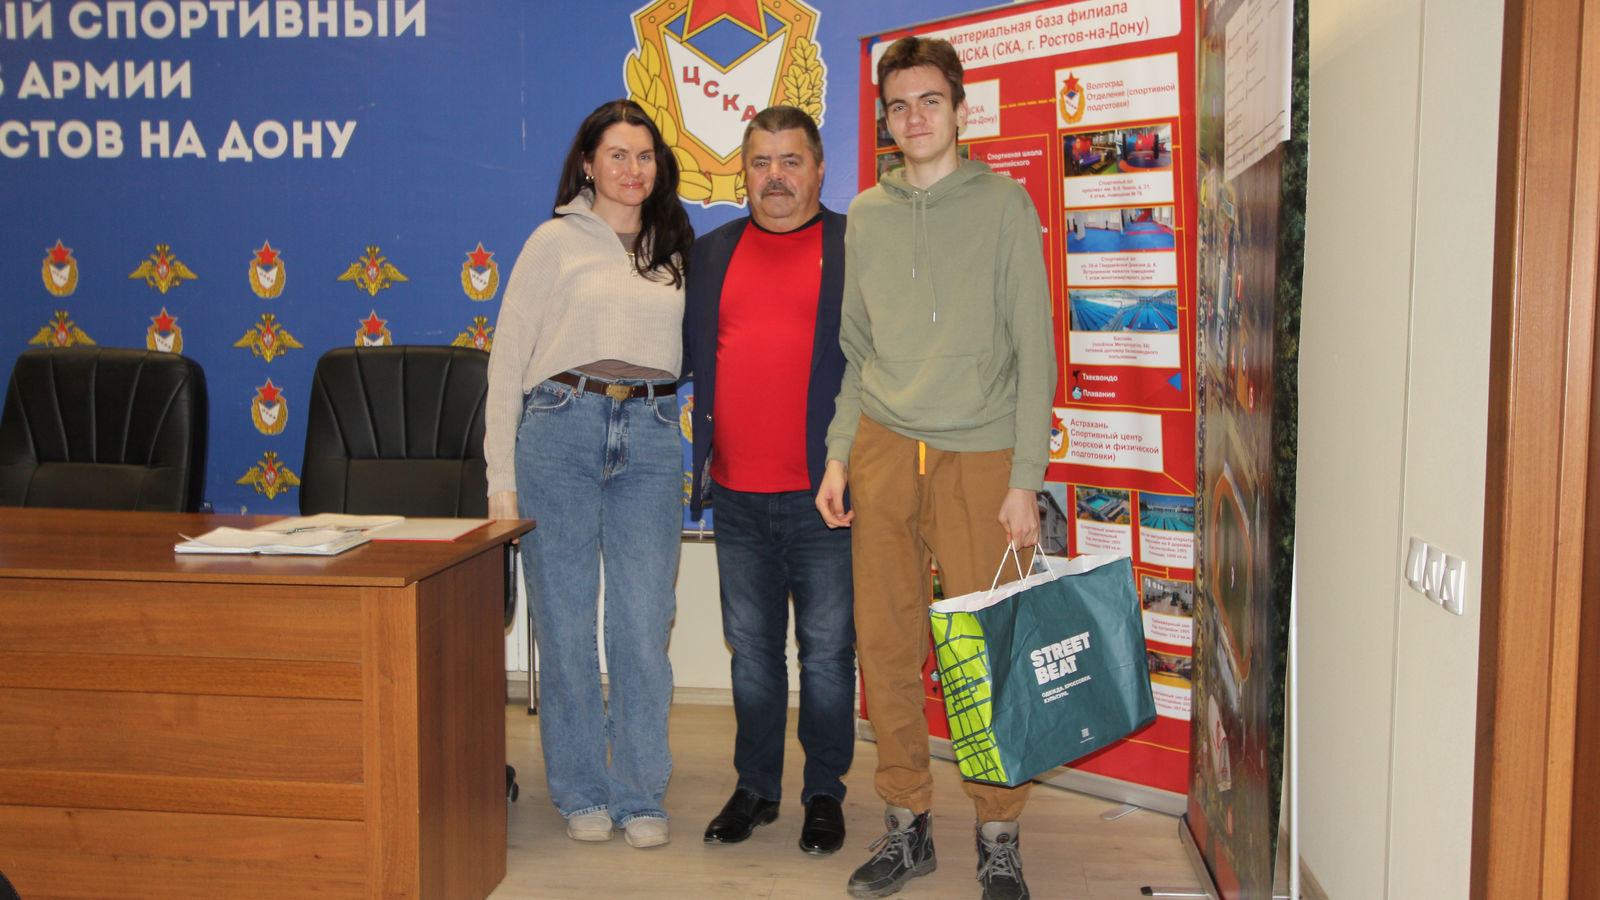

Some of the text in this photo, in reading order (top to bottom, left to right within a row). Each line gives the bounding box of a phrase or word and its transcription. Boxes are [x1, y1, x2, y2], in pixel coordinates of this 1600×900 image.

[69, 0, 426, 38] СПОРТИВНЫЙ
[1035, 14, 1064, 29] база
[1067, 3, 1128, 26] филиала
[992, 42, 1025, 59] (СКА,
[1027, 40, 1036, 50] г.
[1039, 16, 1149, 49] Ростов-на-Дону)
[18, 60, 191, 98] АРМИИ
[1086, 79, 1124, 91] Волгоград
[1087, 84, 1176, 101] Отделение (спортивной
[1087, 100, 1130, 112] подготовки)
[141, 120, 206, 158] НА
[218, 120, 357, 162] ДОНУ
[1083, 389, 1116, 398] Плавание
[1070, 418, 1109, 429] Астрахань
[1070, 429, 1143, 442] Спортивный центр
[1070, 440, 1103, 450] (морской
[1113, 441, 1159, 455] физической
[1071, 450, 1116, 462] подготовки)
[1030, 631, 1091, 667] STREET
[1034, 655, 1078, 685] BEAT
